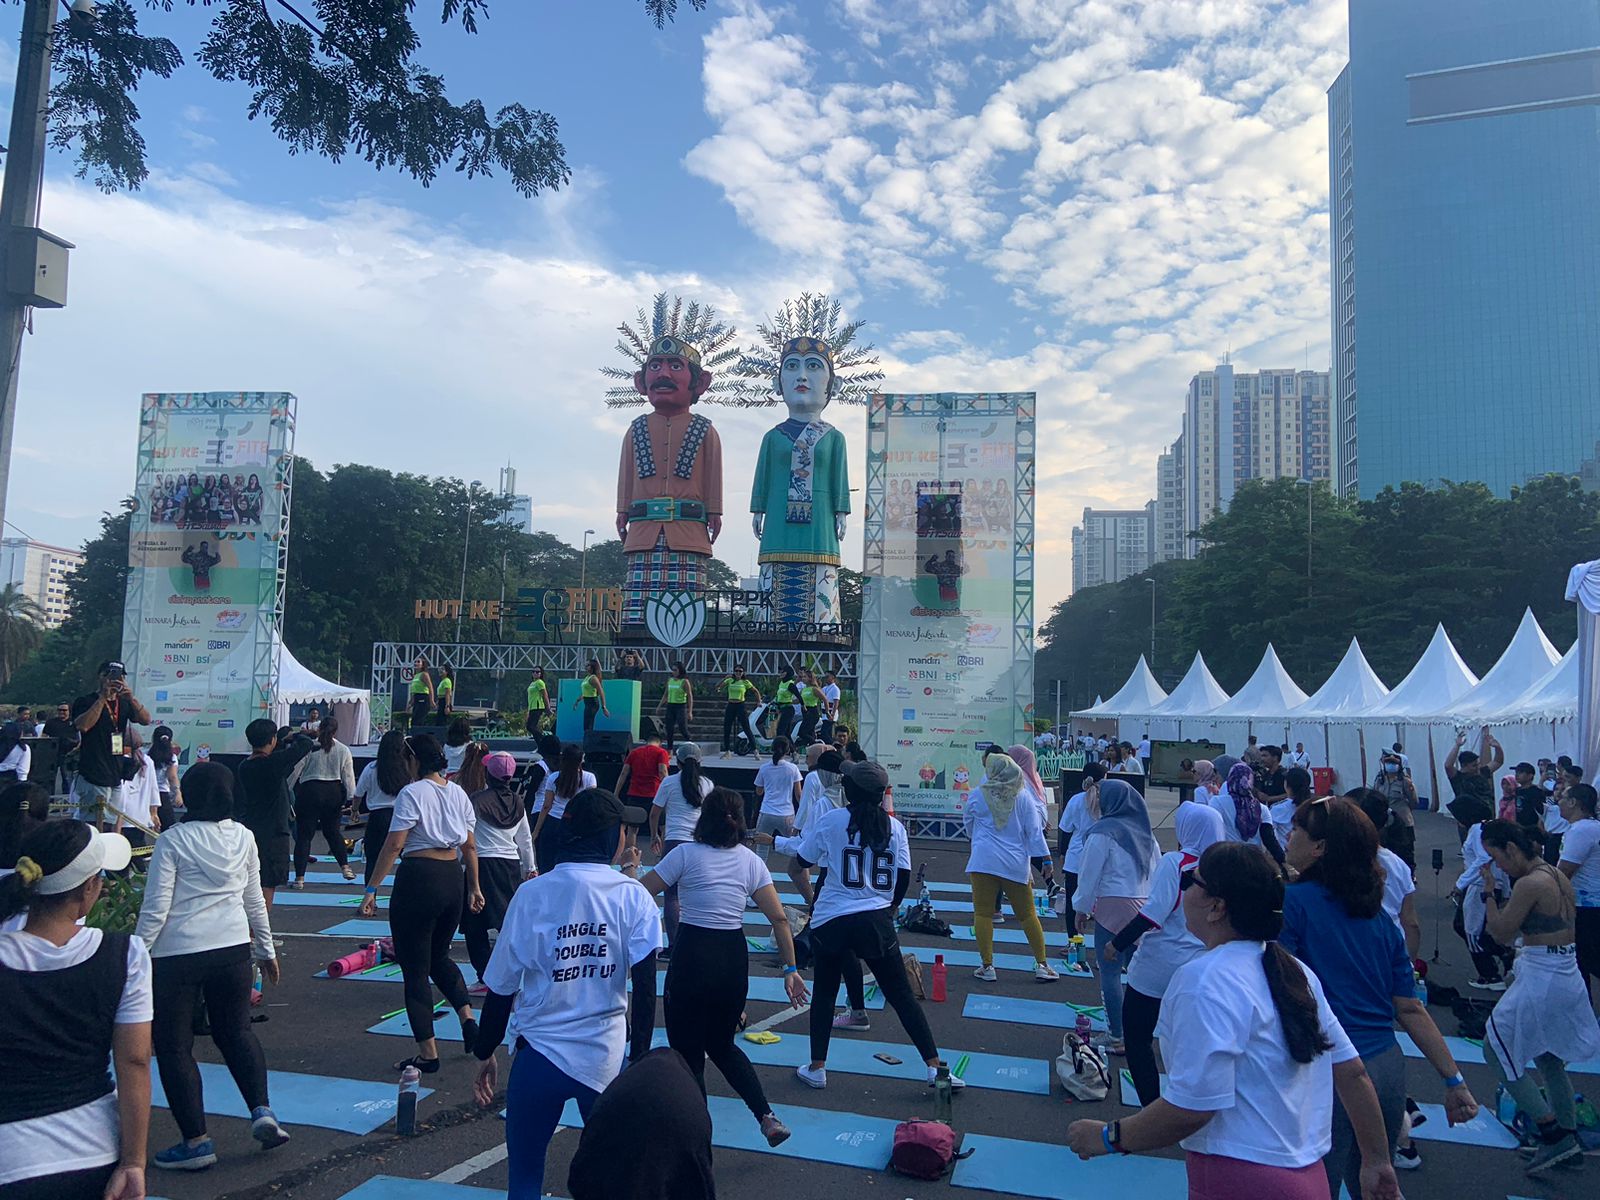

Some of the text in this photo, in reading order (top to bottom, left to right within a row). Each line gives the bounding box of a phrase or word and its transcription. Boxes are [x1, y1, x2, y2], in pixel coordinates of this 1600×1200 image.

[730, 590, 775, 608] PPK
[415, 599, 462, 620] HUT
[570, 609, 622, 633] FUN
[730, 615, 853, 640] Kemayoran
[885, 626, 949, 642] MENARA Jakarta
[164, 641, 193, 650] mandiri
[217, 640, 231, 650] BRI
[172, 654, 190, 663] BNI
[196, 655, 210, 664] BSI
[908, 655, 941, 665] mandiri
[968, 656, 984, 666] BRI
[918, 670, 938, 679] BNI
[945, 672, 961, 681] BSI
[841, 846, 896, 893] 06
[556, 922, 608, 941] SINGLE
[582, 964, 598, 978] IT
[600, 963, 617, 979] UP
